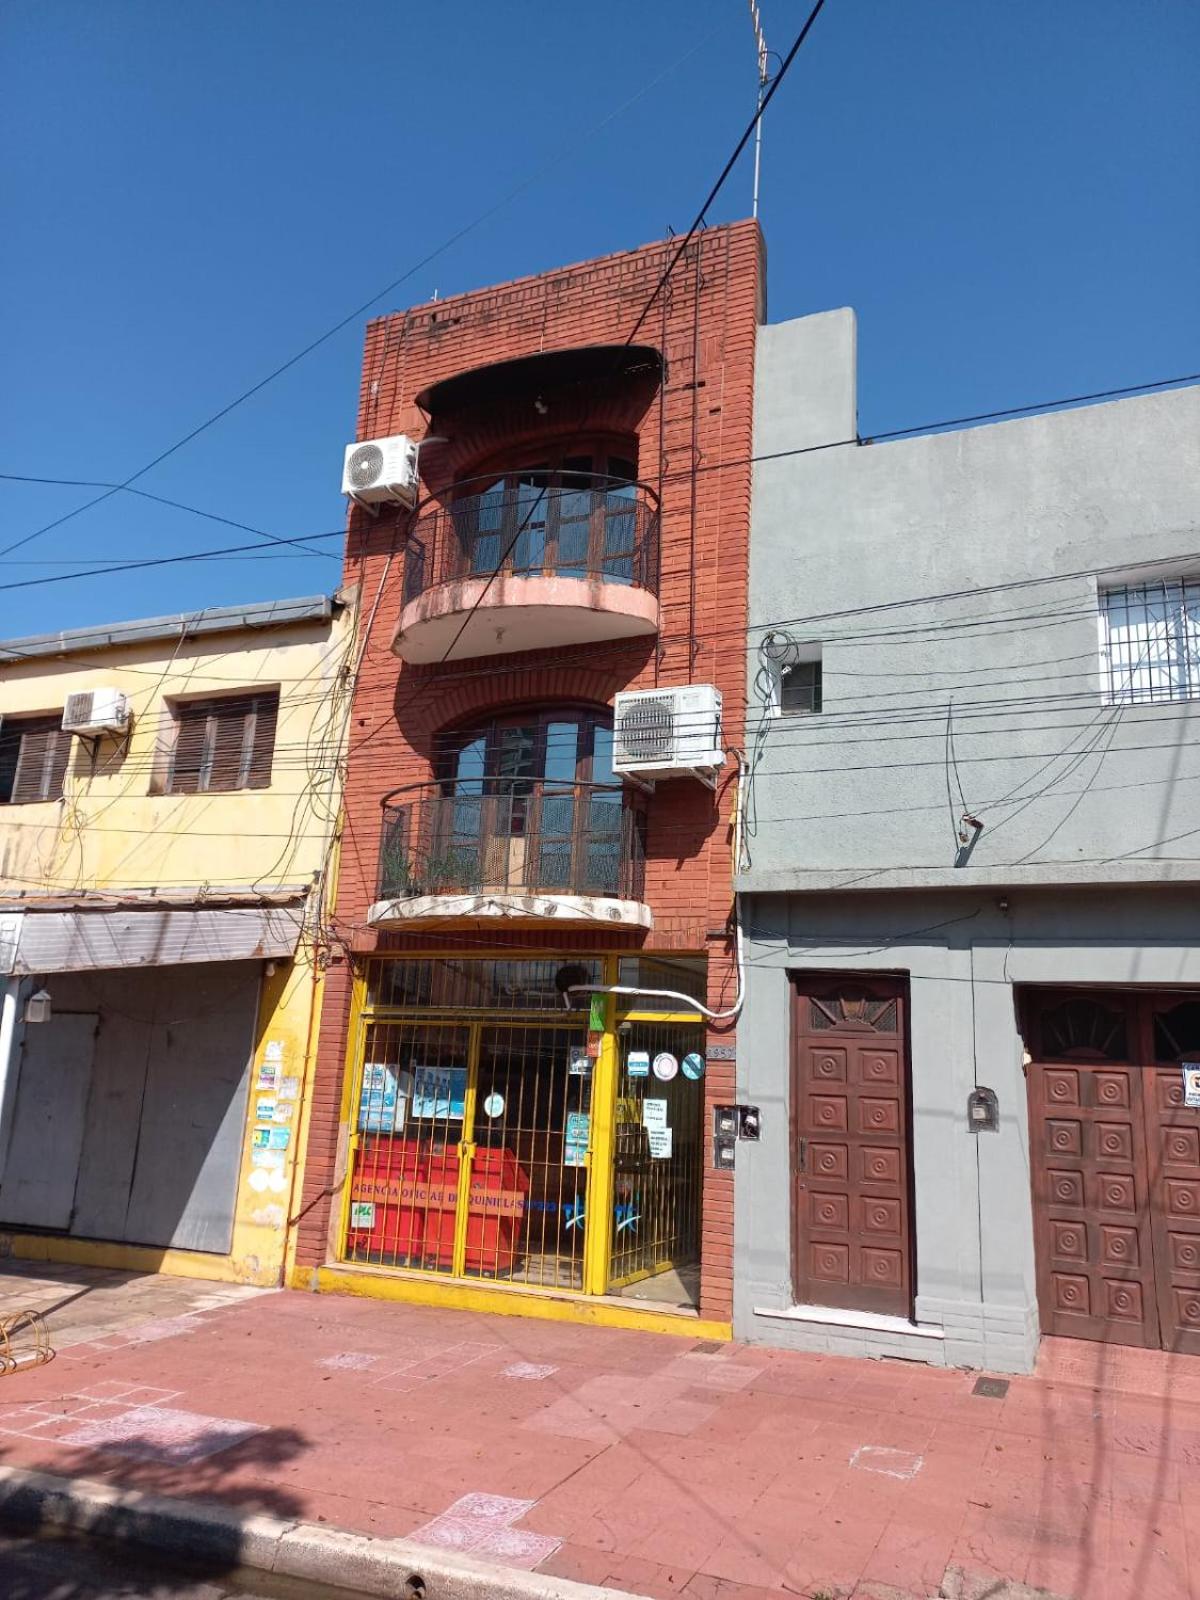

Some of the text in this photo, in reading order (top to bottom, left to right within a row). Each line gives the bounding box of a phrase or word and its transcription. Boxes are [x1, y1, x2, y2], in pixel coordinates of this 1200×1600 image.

[353, 1183, 398, 1198] AGENCIA
[401, 1188, 444, 1202] OICAL
[448, 1193, 459, 1204] D
